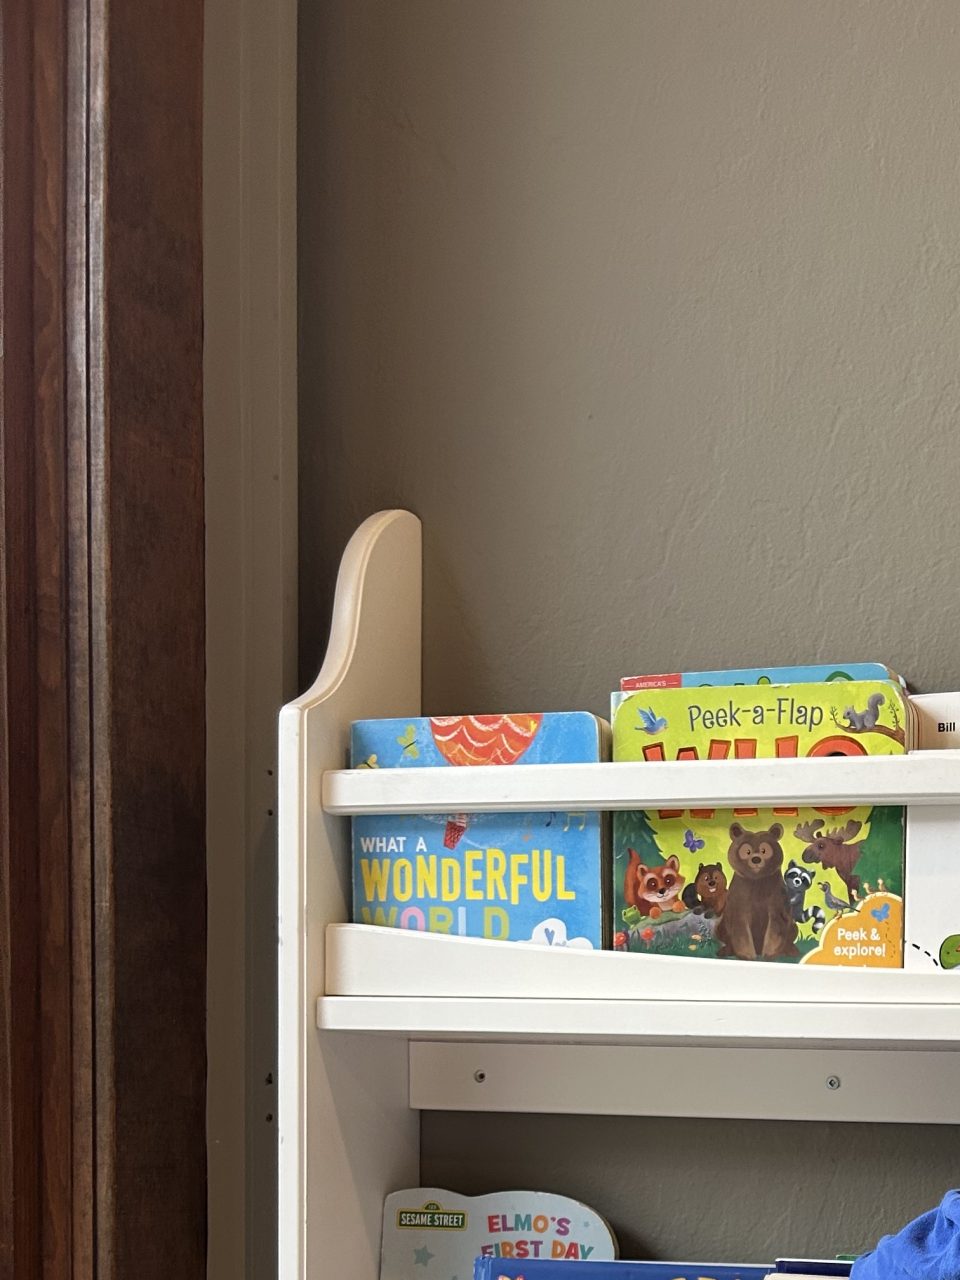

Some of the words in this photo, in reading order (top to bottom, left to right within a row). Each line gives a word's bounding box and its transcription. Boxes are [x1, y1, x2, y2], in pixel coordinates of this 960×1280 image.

[688, 698, 823, 732] Peek-a-Flap
[938, 722, 956, 733] Bill
[360, 837, 406, 852] WHAT
[416, 837, 427, 852] A
[360, 848, 576, 905] WONDERFUL
[838, 927, 868, 941] Peek
[870, 927, 881, 941] &
[833, 943, 886, 959] explore!
[401, 1213, 433, 1226] SESAME
[434, 1213, 464, 1227] STREET
[487, 1213, 571, 1236] ELMO'S
[481, 1240, 543, 1258] FIRST
[551, 1240, 594, 1260] DAY
